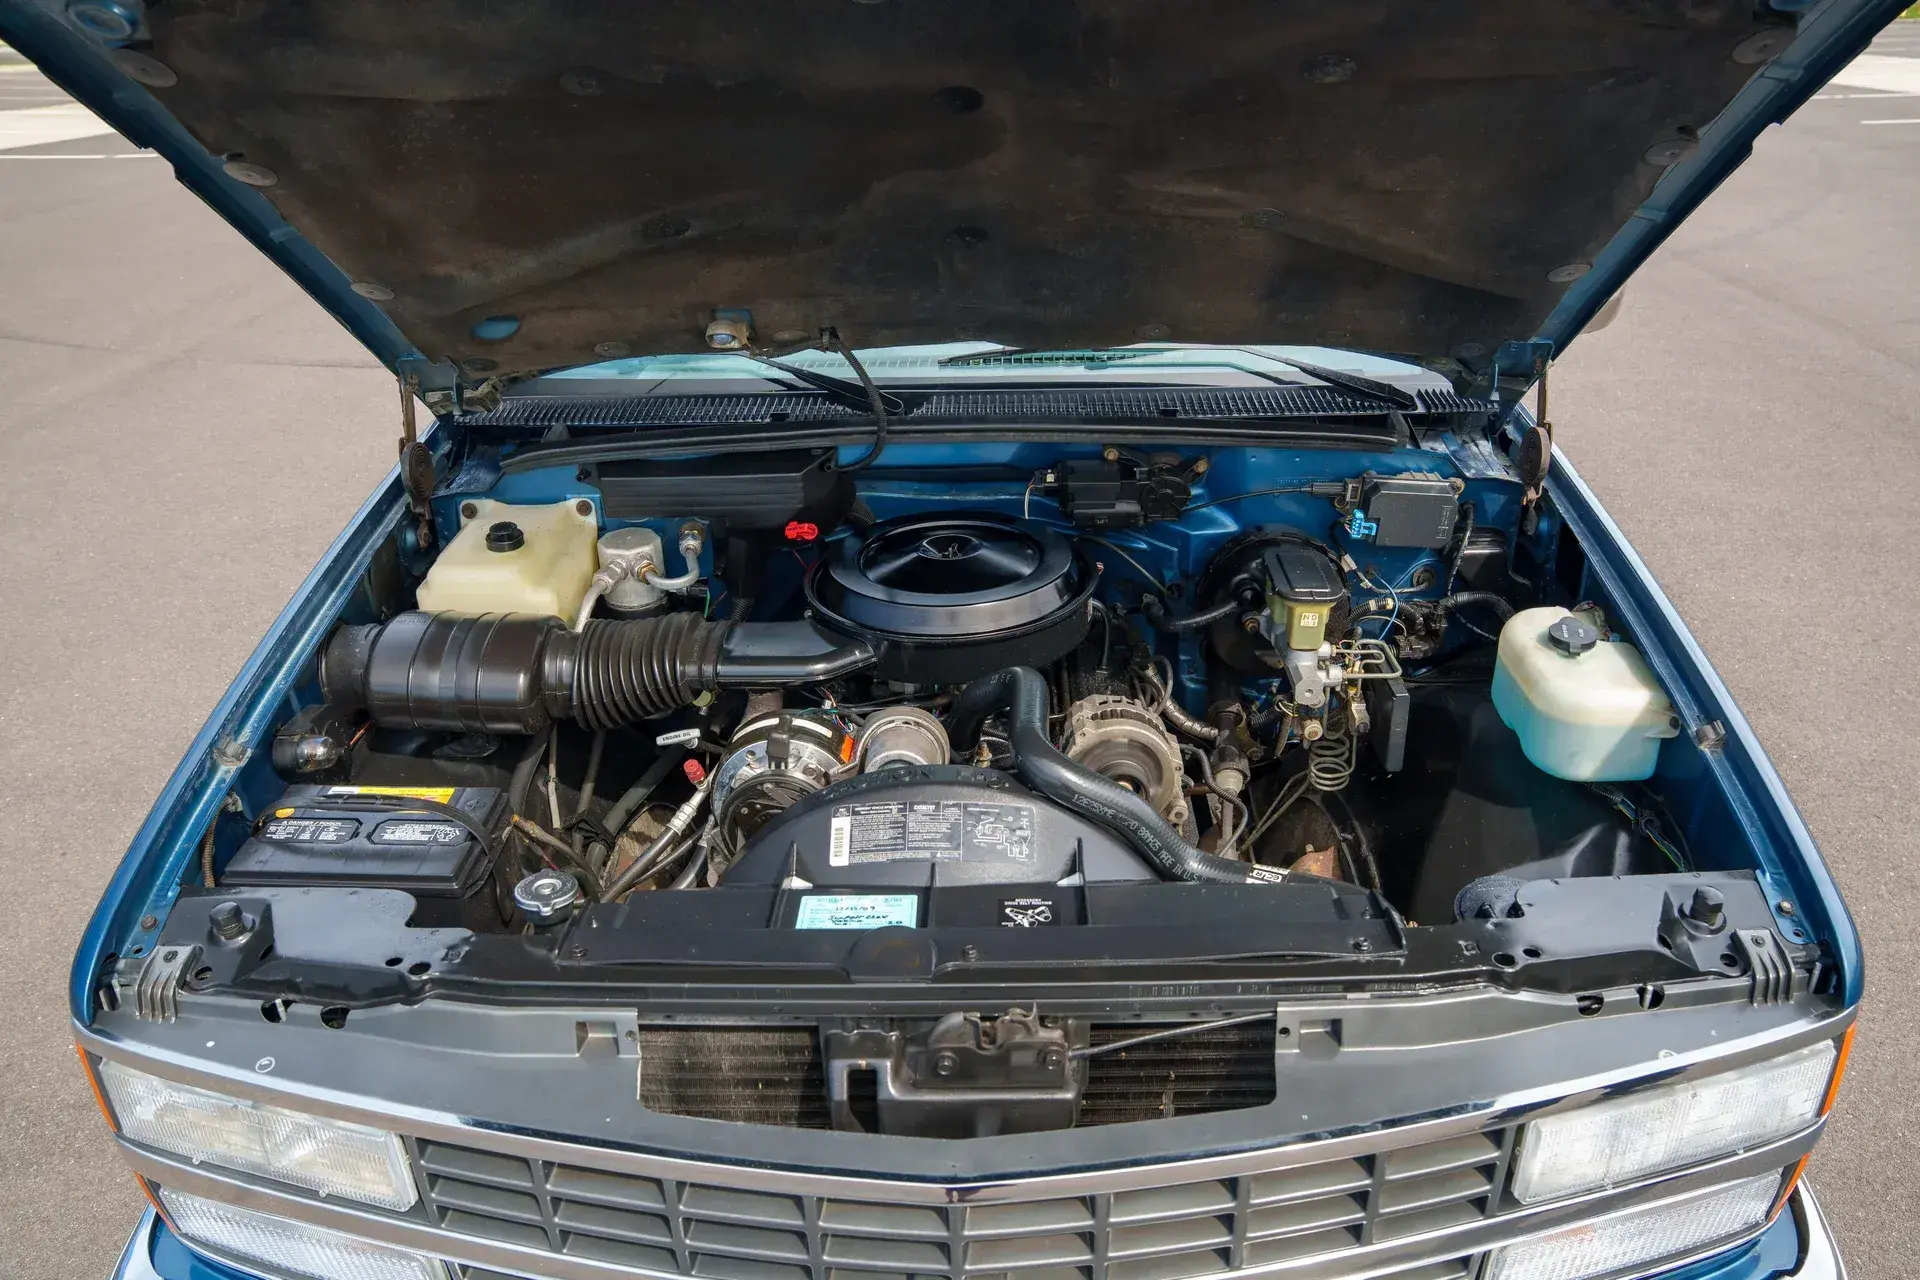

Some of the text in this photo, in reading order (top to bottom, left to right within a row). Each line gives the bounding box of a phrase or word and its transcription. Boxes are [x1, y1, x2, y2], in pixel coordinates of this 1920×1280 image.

[662, 733, 681, 742] ENGINE
[1158, 849, 1175, 867] MADE
[1172, 863, 1183, 877] IN
